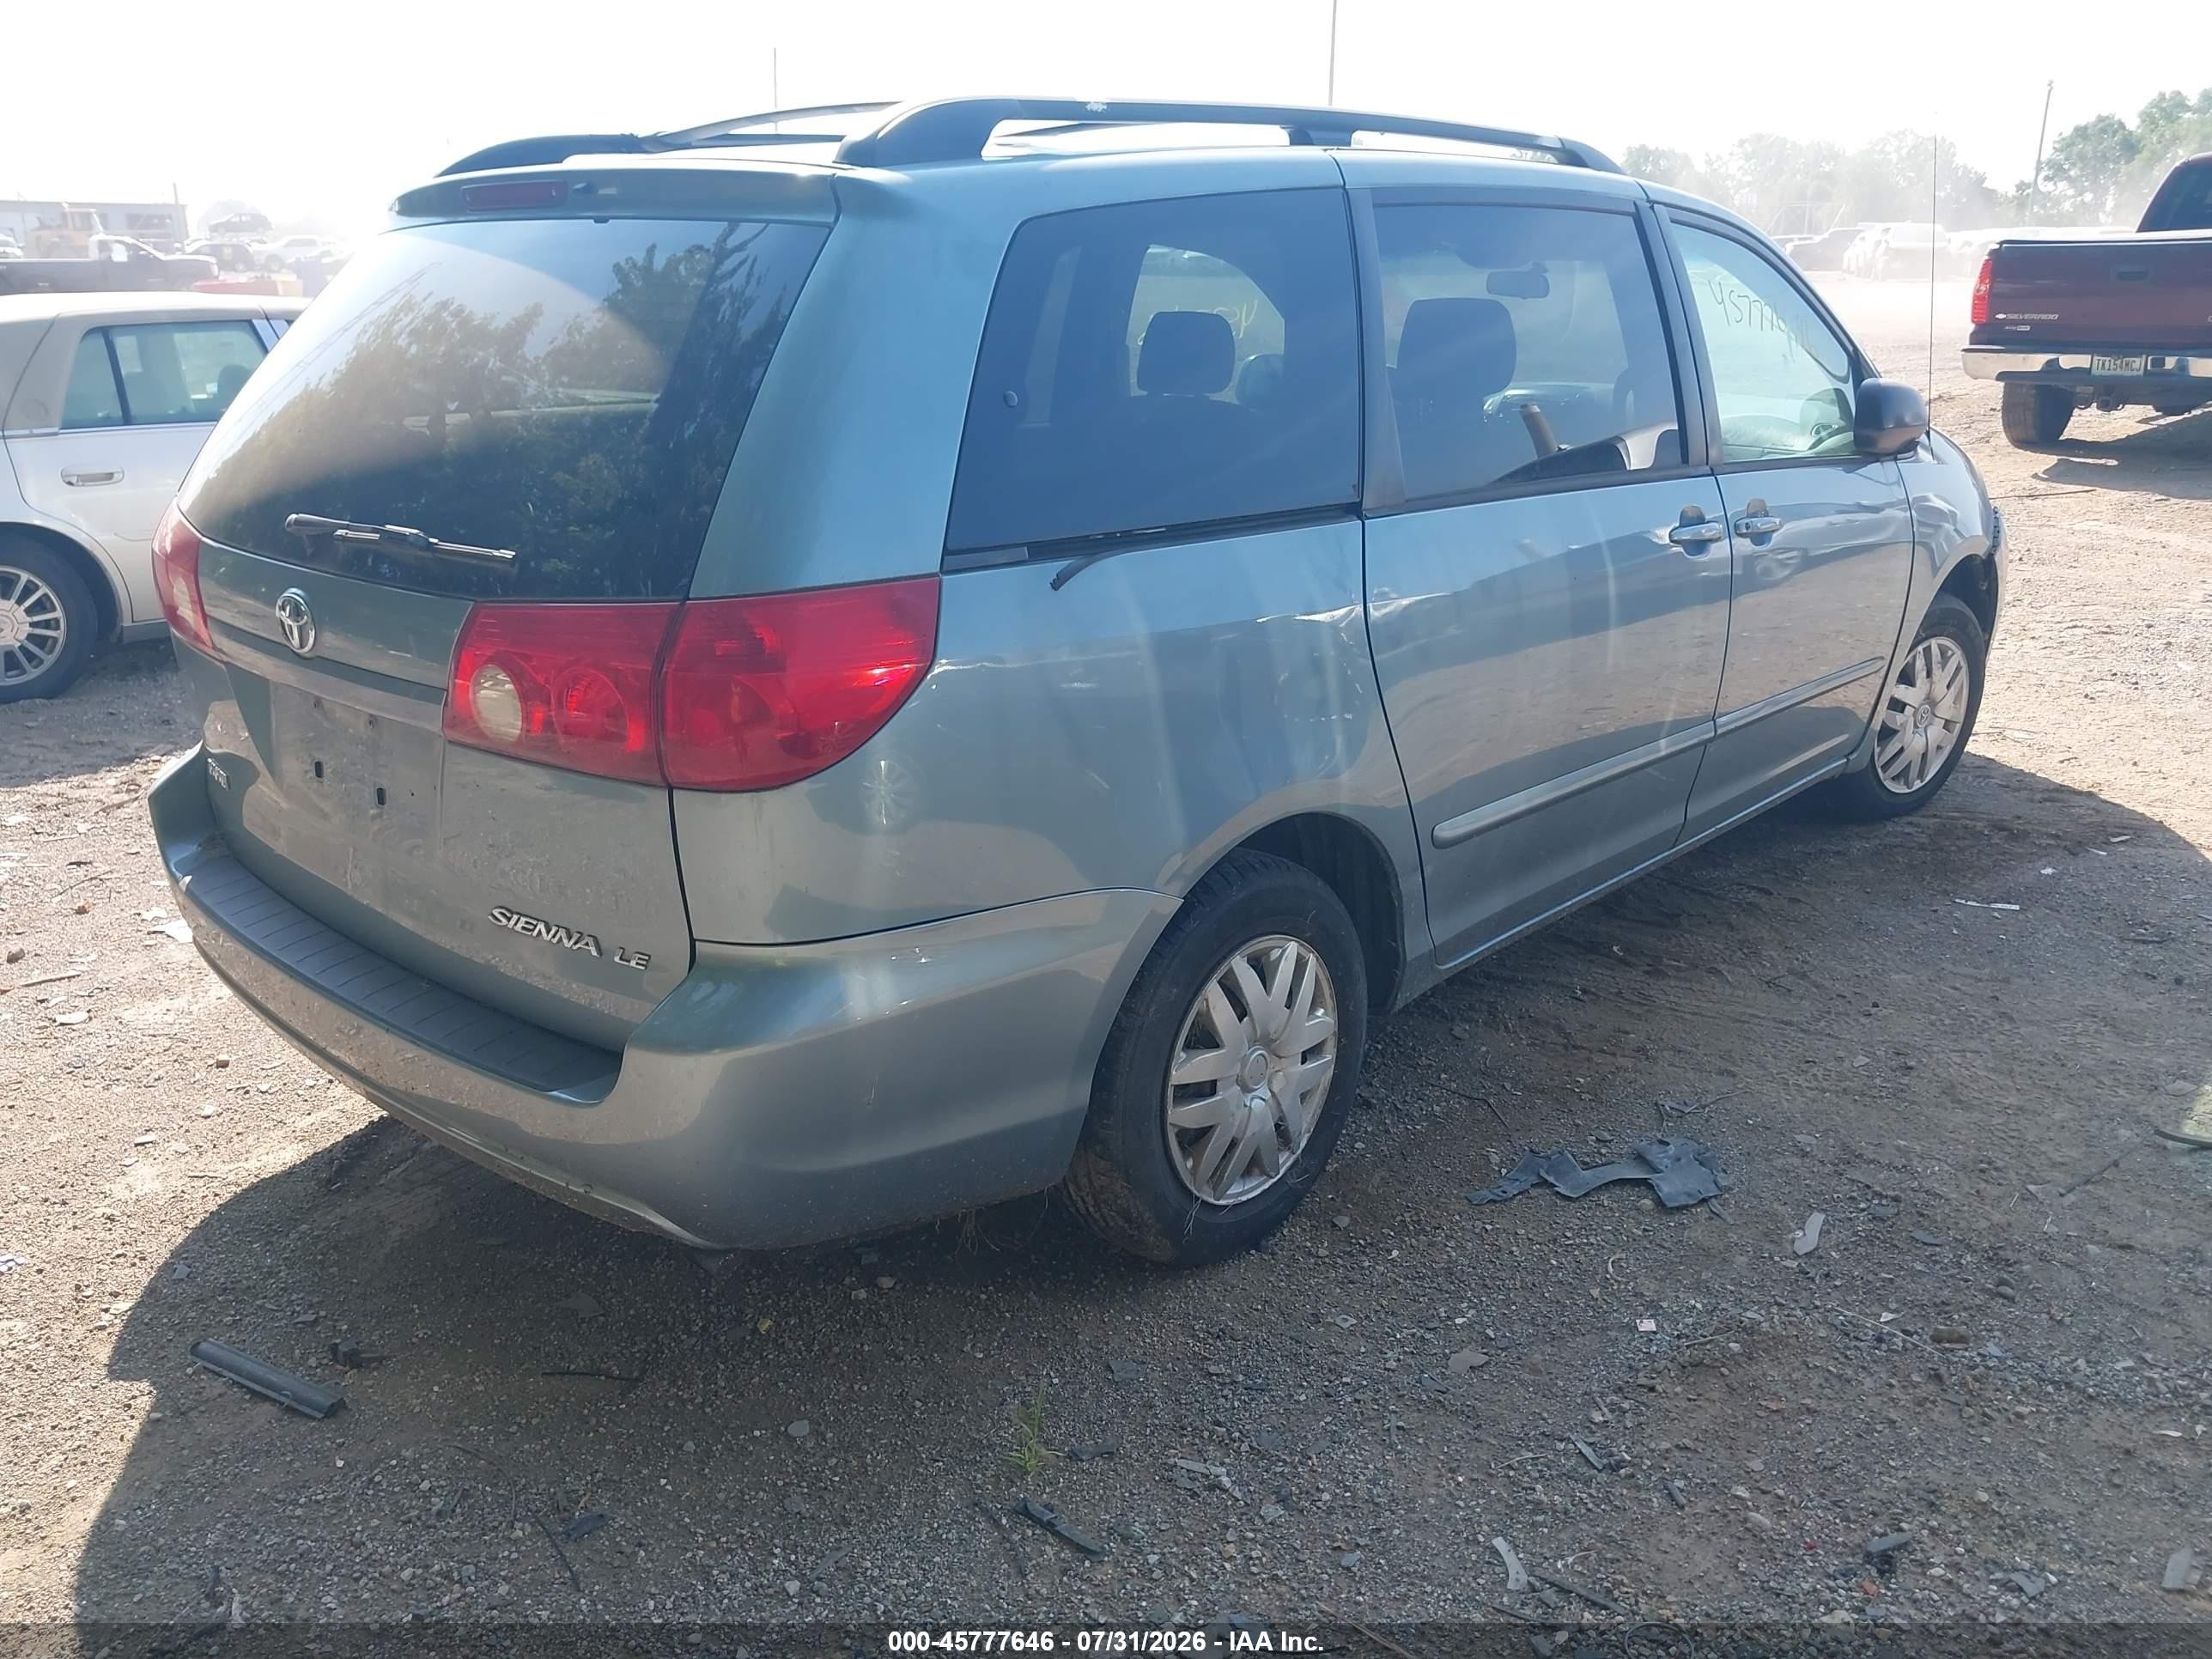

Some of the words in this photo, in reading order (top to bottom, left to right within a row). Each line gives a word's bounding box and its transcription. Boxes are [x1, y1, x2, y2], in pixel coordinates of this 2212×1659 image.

[2005, 313, 2059, 321] SILVERADO
[488, 906, 603, 957] SIENNA
[613, 947, 652, 970] LE
